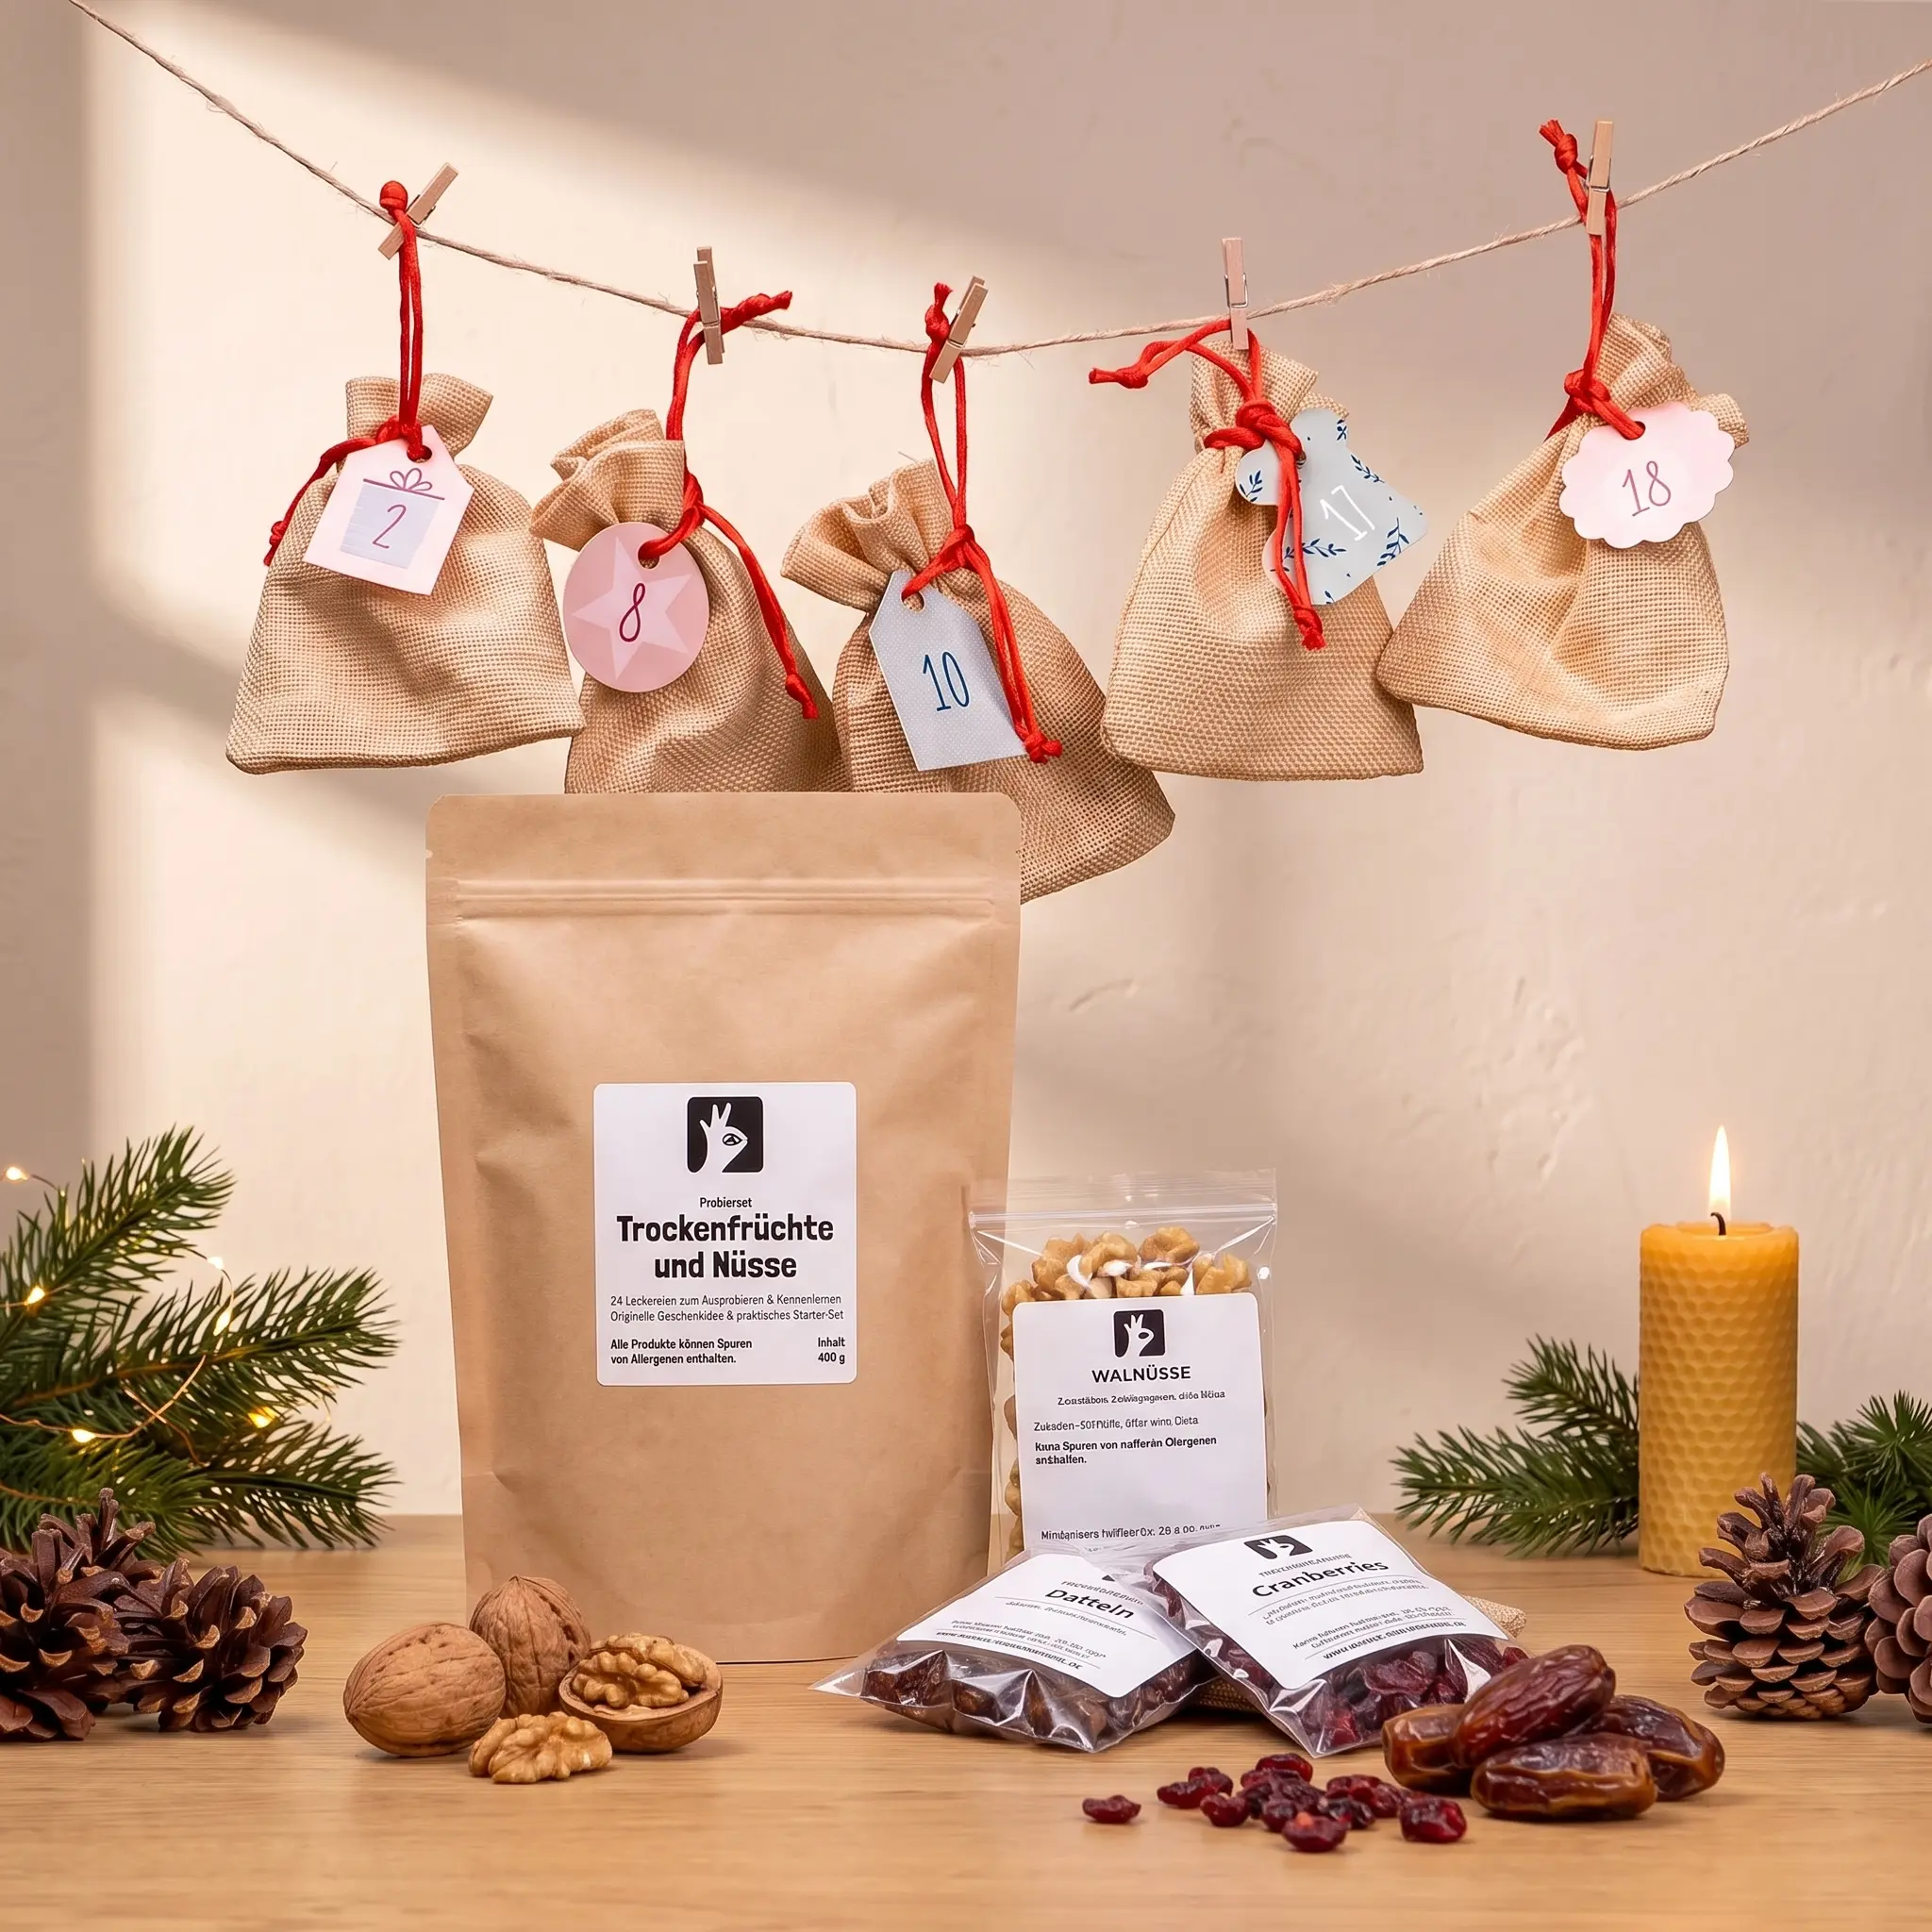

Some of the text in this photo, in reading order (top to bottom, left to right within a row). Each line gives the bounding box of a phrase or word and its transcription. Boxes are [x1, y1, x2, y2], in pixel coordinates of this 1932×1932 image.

[1623, 460, 1671, 516] 18
[1320, 485, 1375, 541] 17
[373, 504, 407, 549] 2
[619, 583, 645, 642] 8
[923, 652, 969, 711] 10
[699, 1196, 753, 1208] Probierset
[616, 1212, 834, 1242] Trockenfrüchte
[654, 1249, 797, 1279] und Nüsse
[610, 1295, 624, 1307] 24
[625, 1294, 677, 1307] Leckereien
[678, 1297, 700, 1307] zum
[701, 1293, 764, 1308] Ausprobieren
[766, 1293, 774, 1306] &
[610, 1308, 844, 1324] Originelle Geschenkidee & praktisches Starter-Set
[609, 1338, 753, 1352] Alle Produkte können Spuren
[817, 1336, 846, 1348] Inhalt
[610, 1352, 737, 1367] von Allergenen enthalten.
[817, 1351, 845, 1365] 400 g
[1091, 1363, 1191, 1384] WALNÜSSE
[1062, 1441, 1098, 1454] Spuren
[1099, 1441, 1119, 1450] von
[1252, 1559, 1389, 1598] Cranberries
[1044, 1589, 1134, 1619] Datteln
